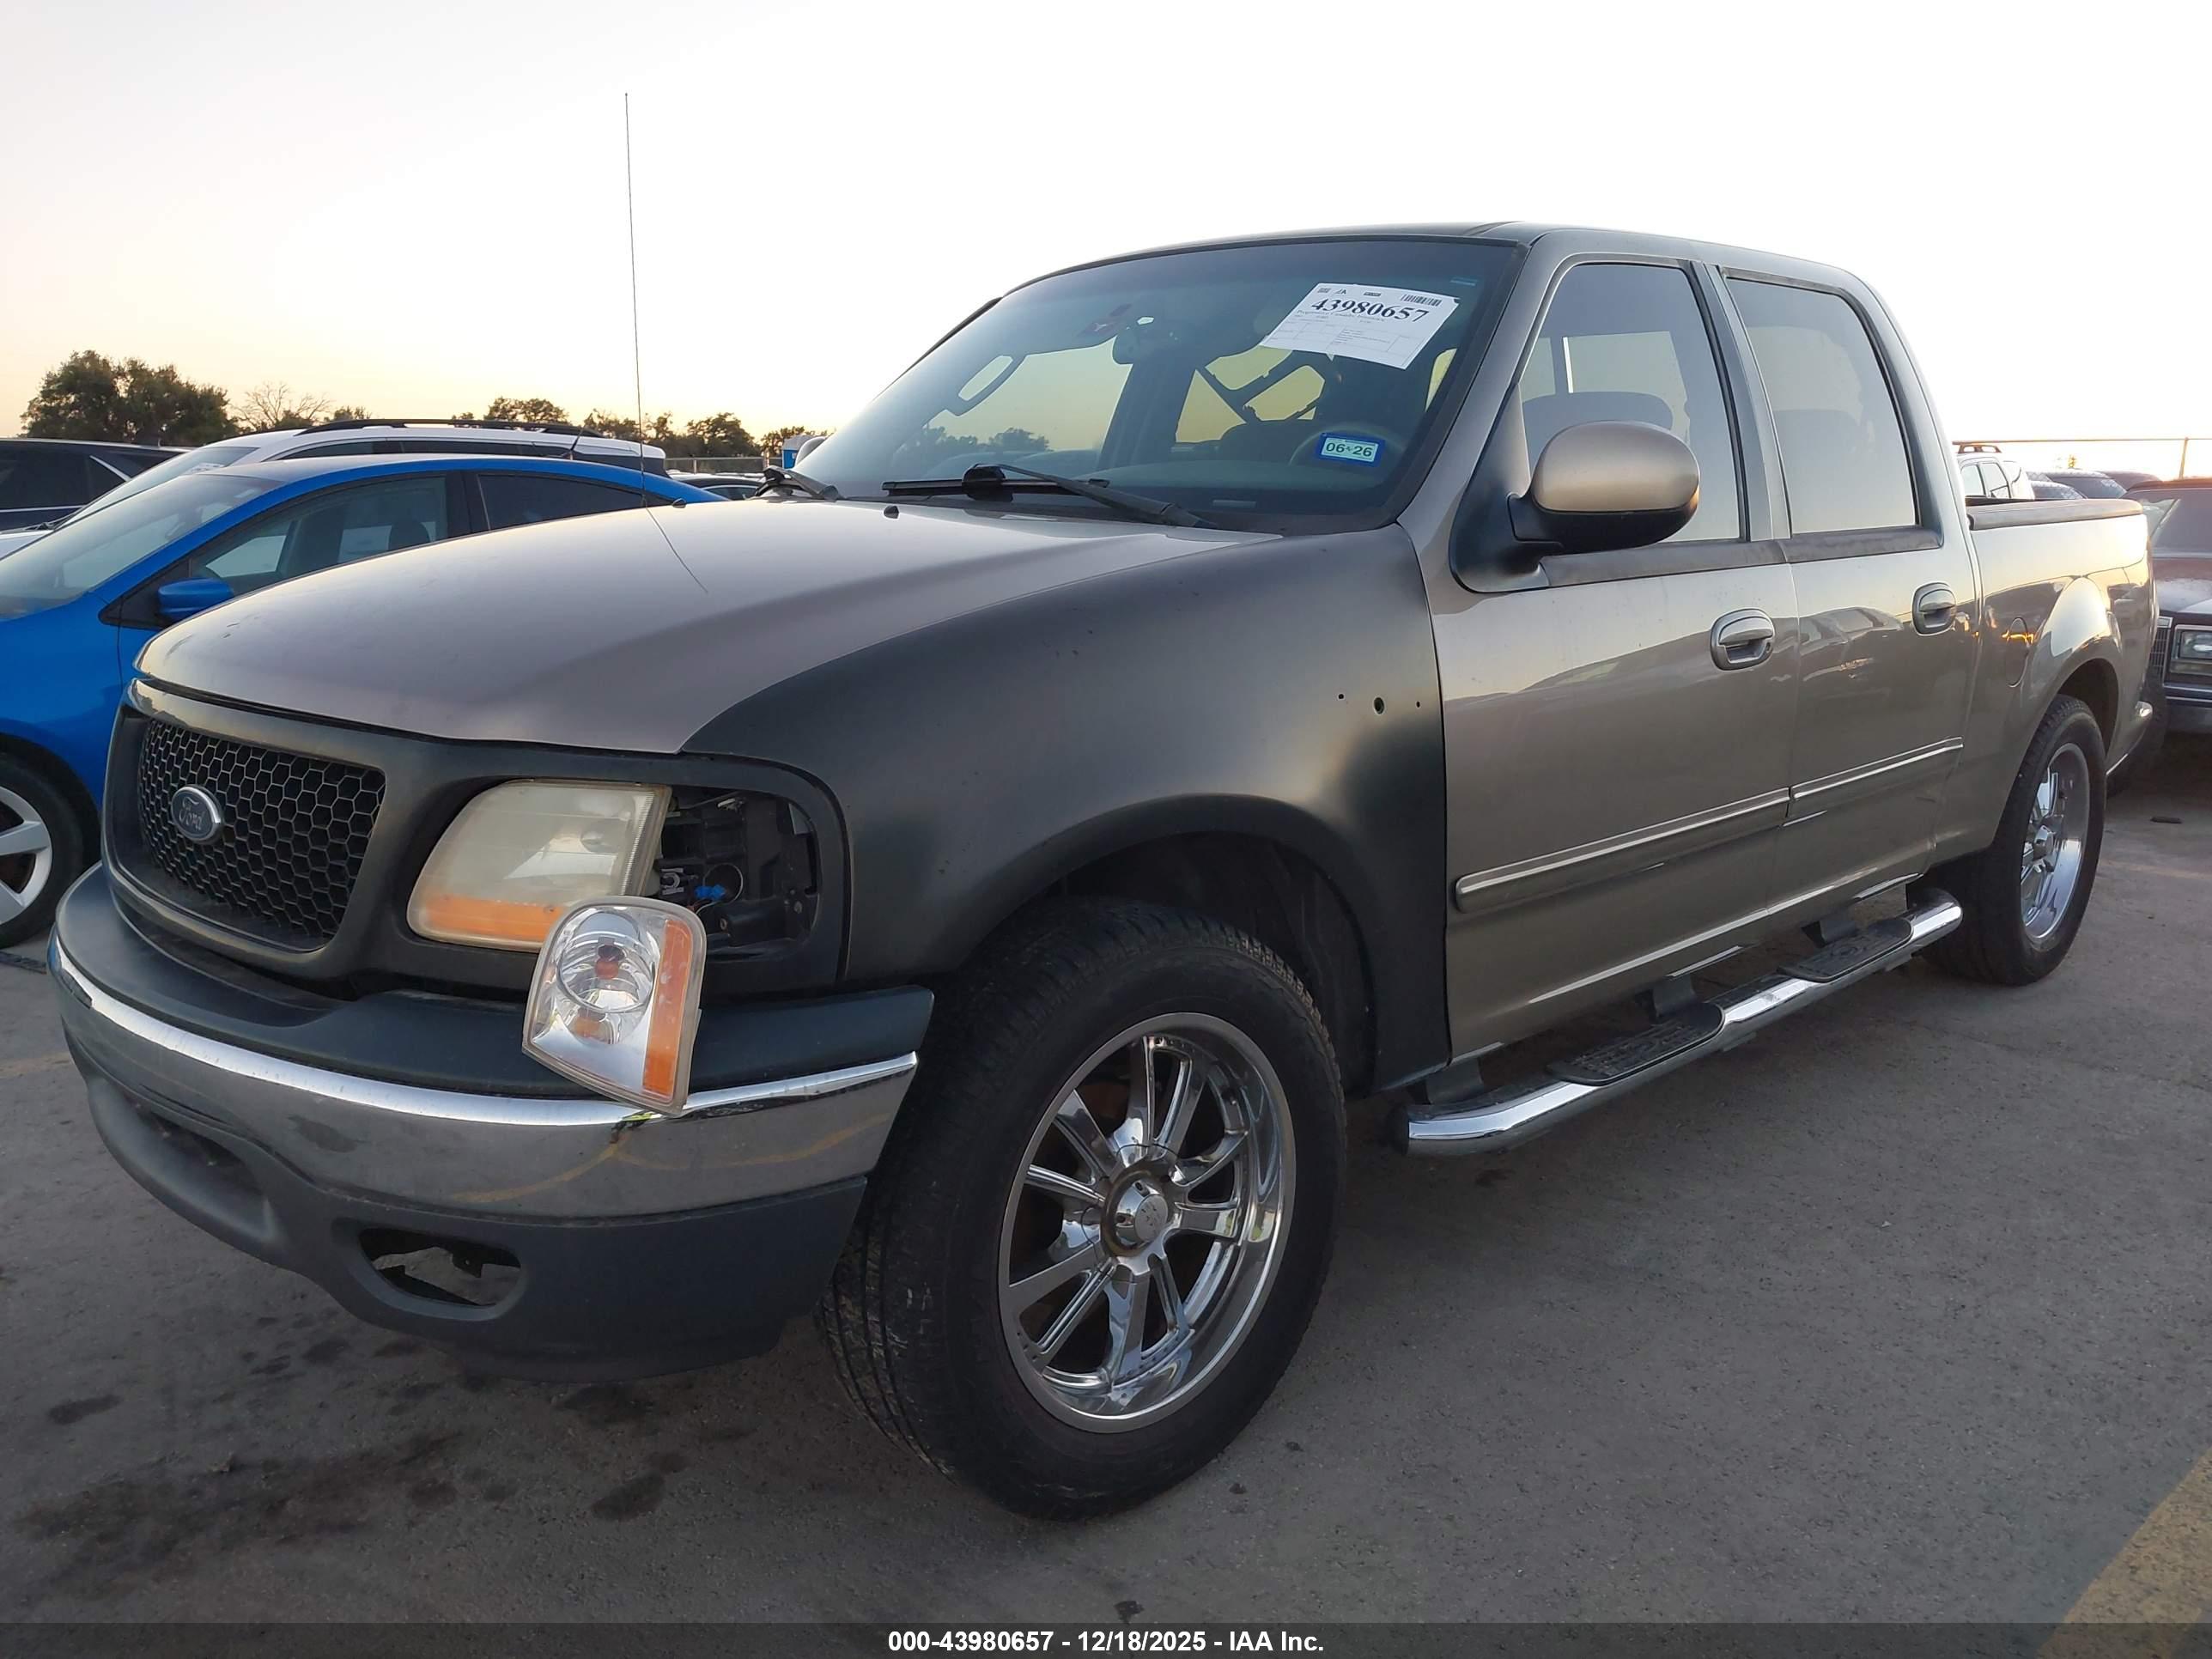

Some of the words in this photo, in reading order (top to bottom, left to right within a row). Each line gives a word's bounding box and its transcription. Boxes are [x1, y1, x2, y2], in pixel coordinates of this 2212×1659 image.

[1311, 298, 1429, 322] 43980657
[1326, 442, 1346, 453] 06
[1352, 446, 1373, 457] 26
